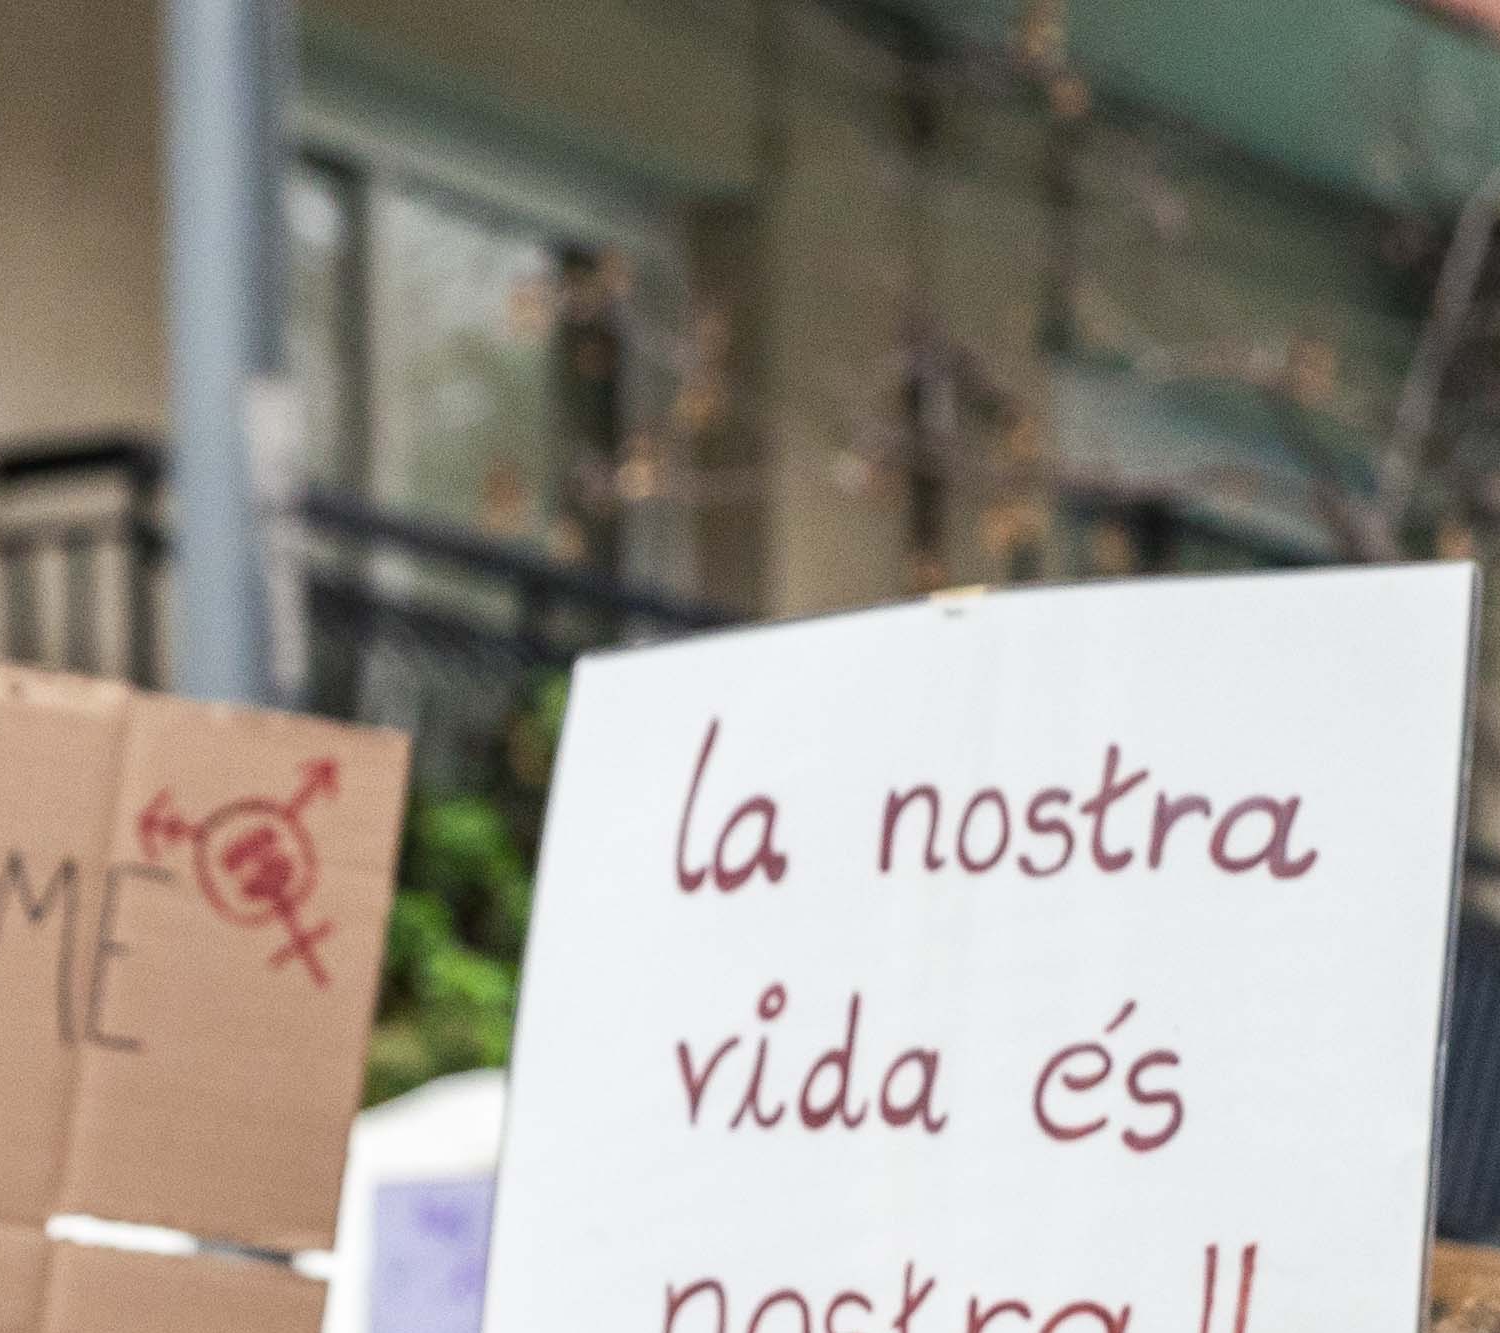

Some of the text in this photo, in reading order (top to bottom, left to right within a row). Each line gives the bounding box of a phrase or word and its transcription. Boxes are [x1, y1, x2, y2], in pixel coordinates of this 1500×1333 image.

[674, 718, 1320, 894] la nostra
[675, 982, 1186, 1155] vida és
